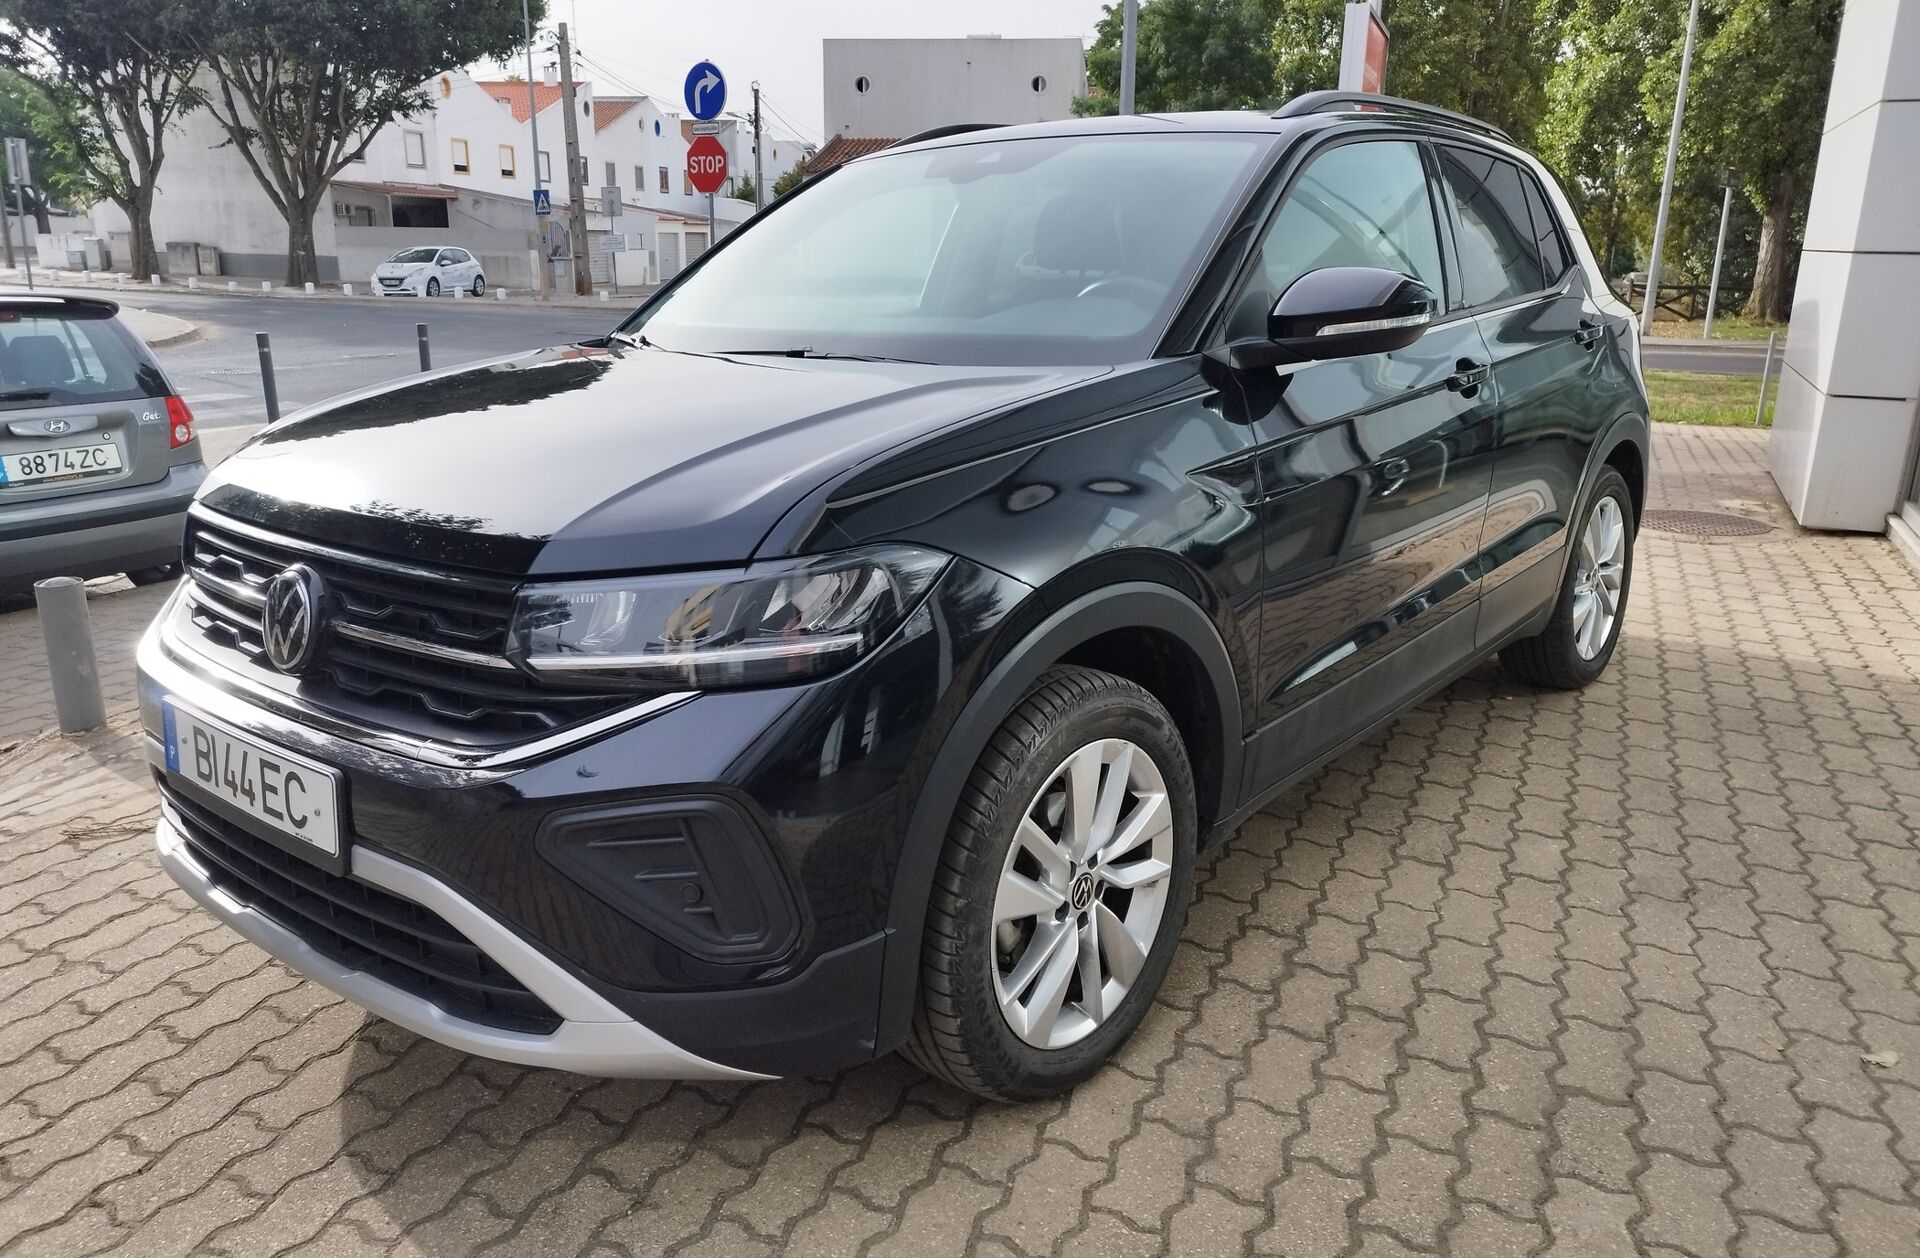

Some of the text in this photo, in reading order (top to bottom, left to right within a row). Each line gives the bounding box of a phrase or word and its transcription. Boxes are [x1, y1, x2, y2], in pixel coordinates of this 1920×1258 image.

[690, 155, 724, 174] STOP
[142, 411, 162, 422] Get
[19, 448, 107, 476] 8874ZC
[169, 745, 176, 760] P
